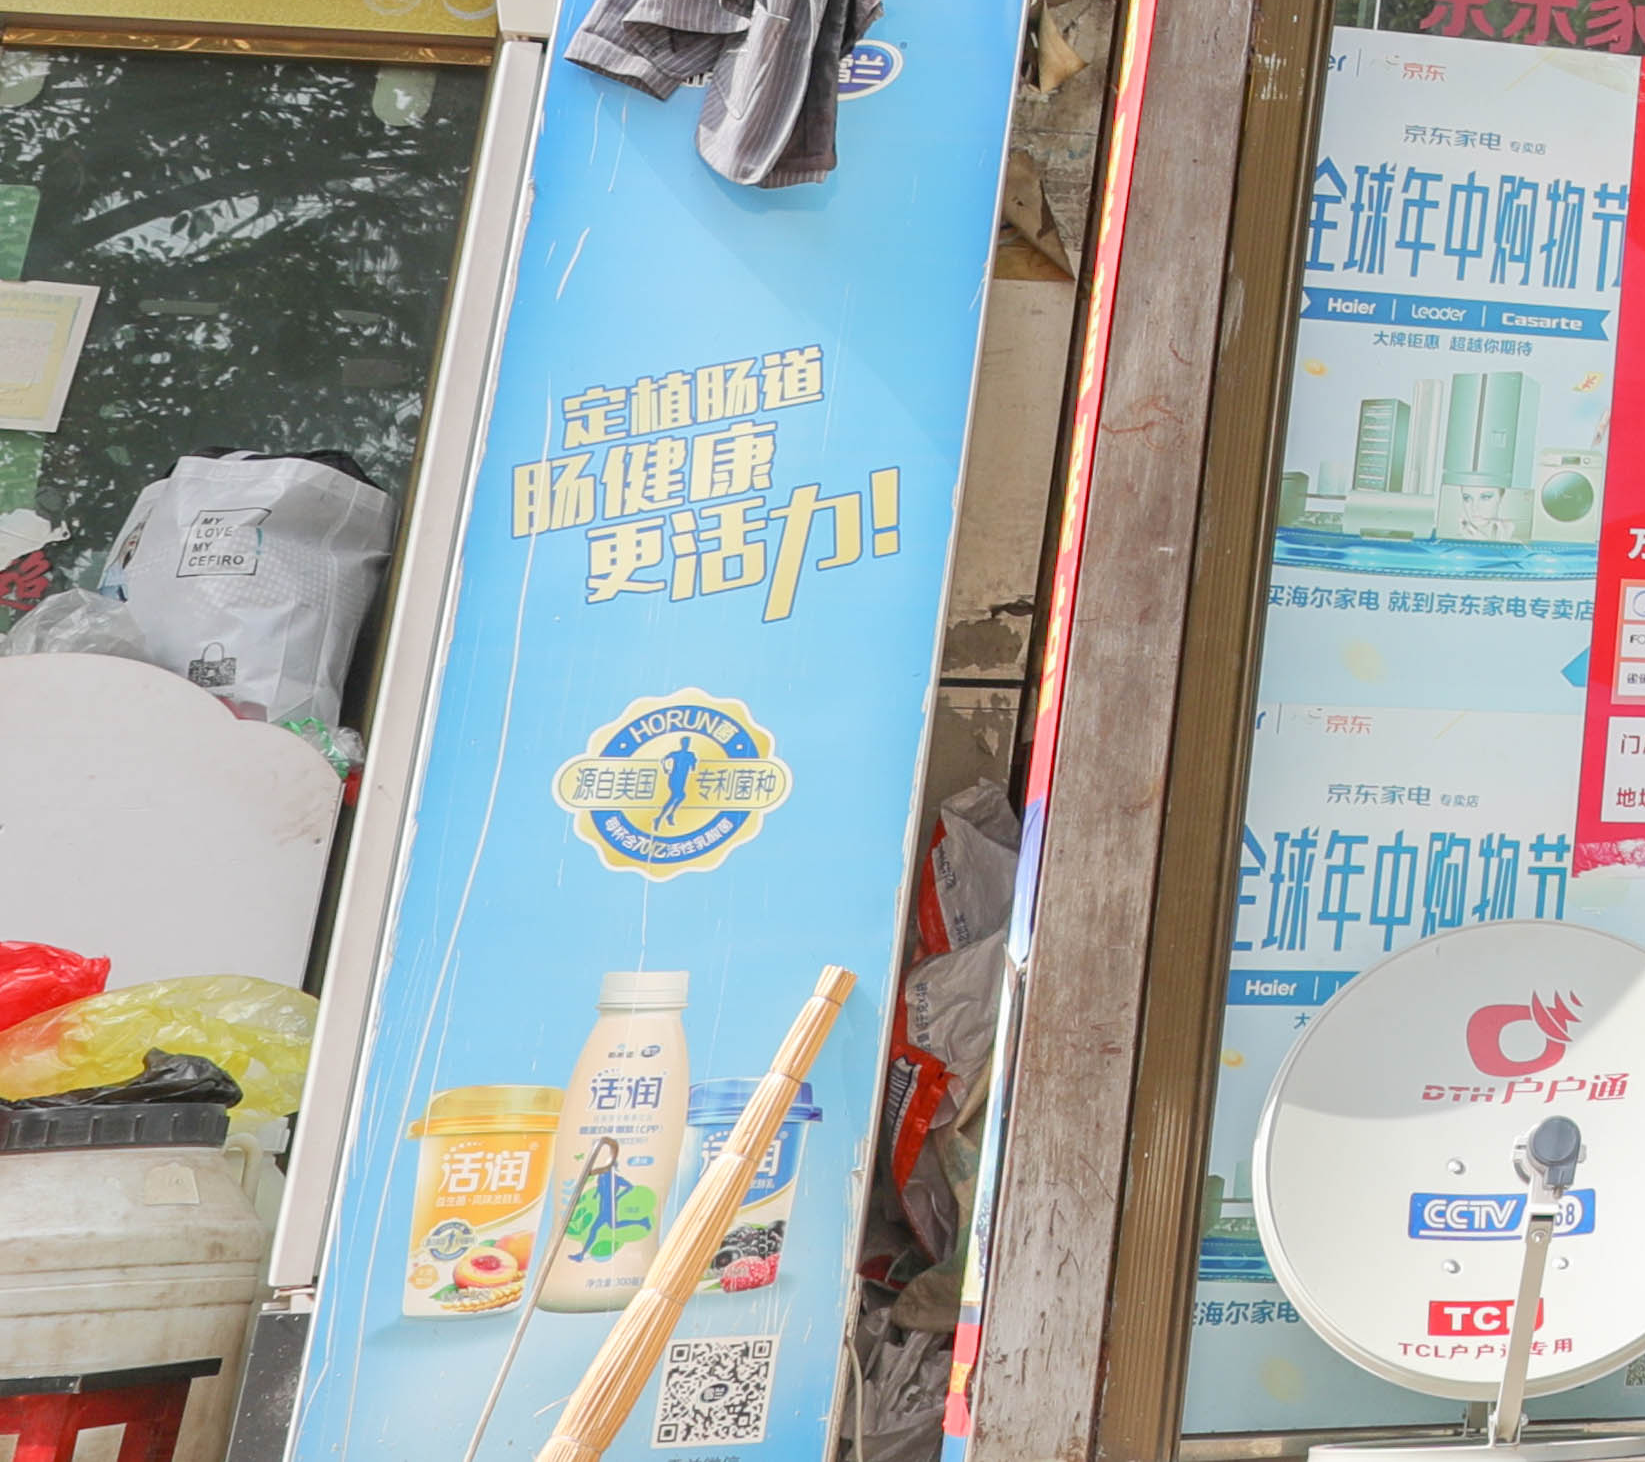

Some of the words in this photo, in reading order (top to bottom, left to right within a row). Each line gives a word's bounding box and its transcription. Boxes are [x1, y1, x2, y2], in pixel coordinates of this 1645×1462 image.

[1402, 63, 1449, 83] 京东
[1403, 125, 1502, 152] 京东家电
[1305, 156, 1629, 292] 全球年中购物节
[1327, 297, 1378, 316] Haier
[1411, 304, 1467, 322] Leader
[1501, 312, 1584, 331] Casarte
[1372, 330, 1440, 351] 大牌钜惠
[1449, 336, 1533, 357] 超越你期待
[561, 344, 824, 450] 定植肠道
[510, 421, 777, 540] 肠健康
[192, 542, 212, 553] MY
[195, 526, 234, 539] LOVE
[188, 554, 245, 568] CEFIRO
[572, 767, 658, 800] 源自美国
[696, 769, 776, 801] 专利菌种
[1327, 783, 1432, 807] 京东家电
[1244, 979, 1298, 998] Haier
[589, 1076, 664, 1110] 活润
[1501, 1073, 1630, 1105] 户户通
[438, 1148, 533, 1194] 活润
[1423, 1199, 1518, 1230] CCTV
